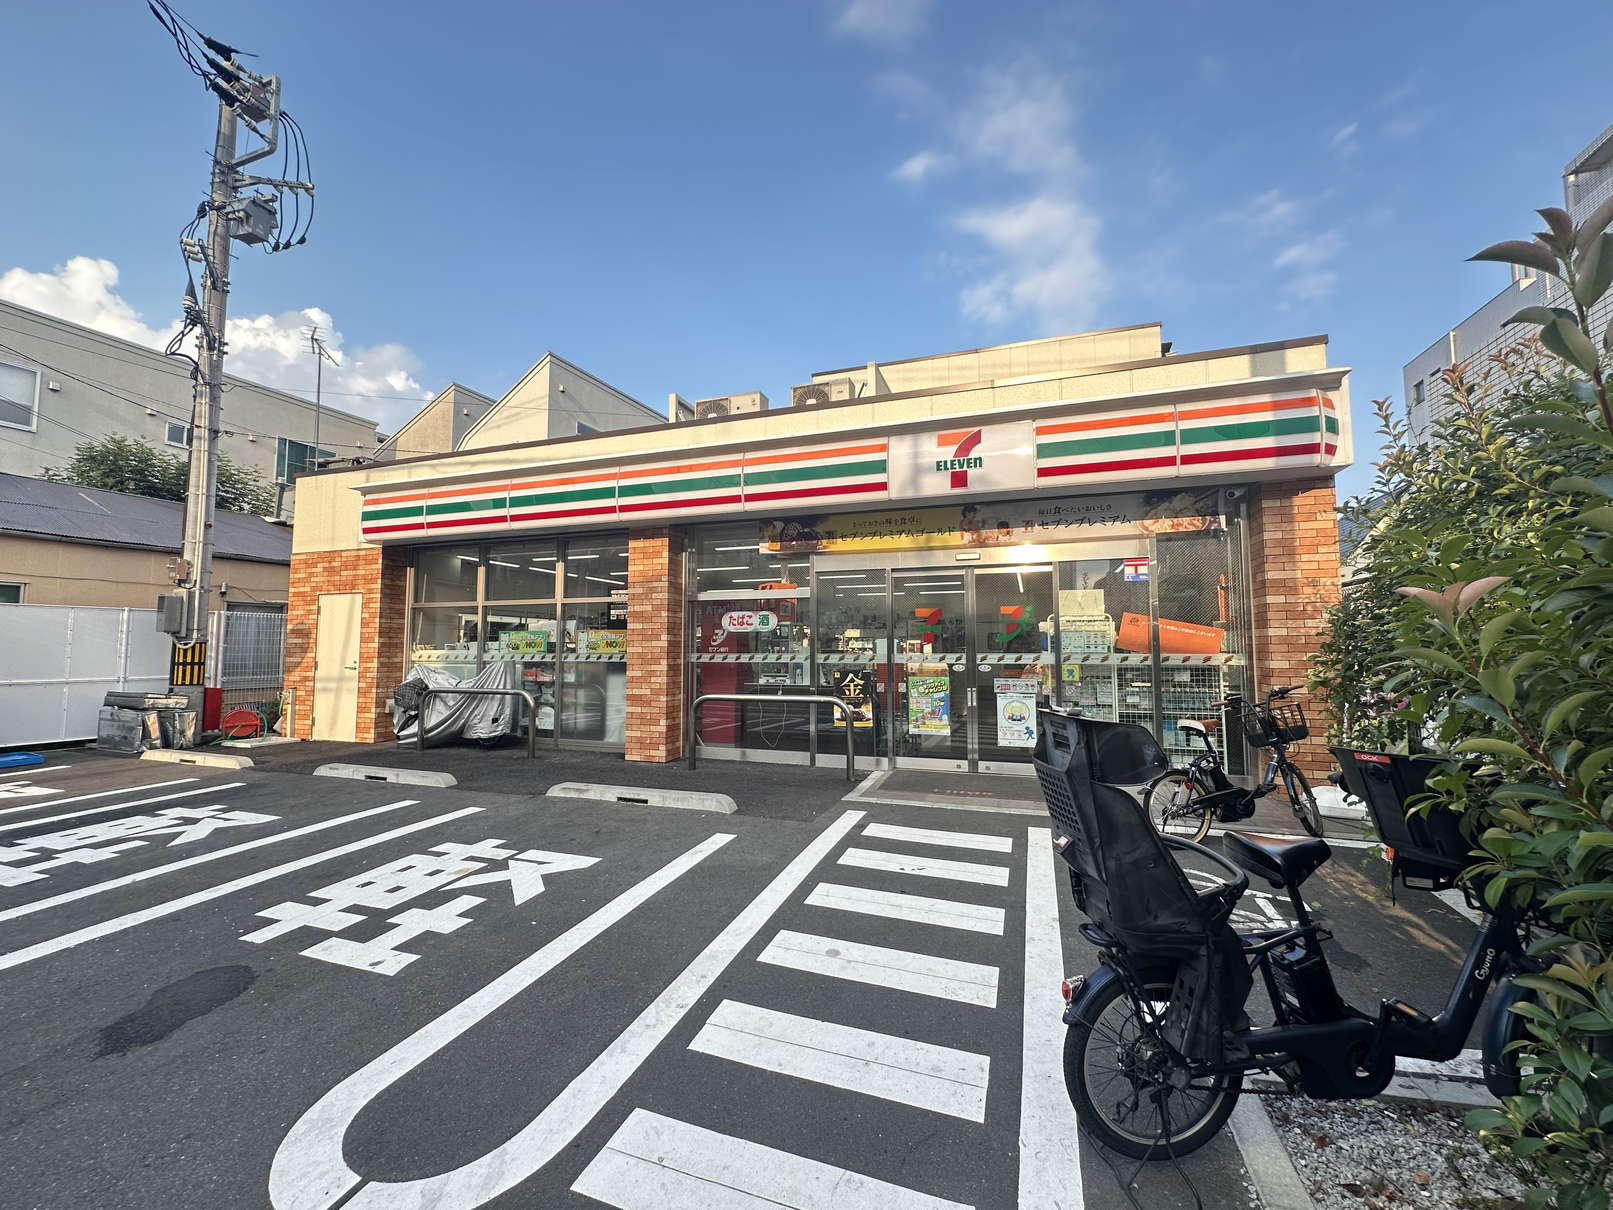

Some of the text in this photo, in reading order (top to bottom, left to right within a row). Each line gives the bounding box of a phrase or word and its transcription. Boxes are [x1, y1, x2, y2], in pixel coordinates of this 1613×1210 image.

[1038, 513, 1131, 530] セブンプレミアム
[840, 526, 957, 542] セブンプレミアムゴールド
[728, 614, 770, 627] たばこ 酒
[840, 672, 865, 698] 金
